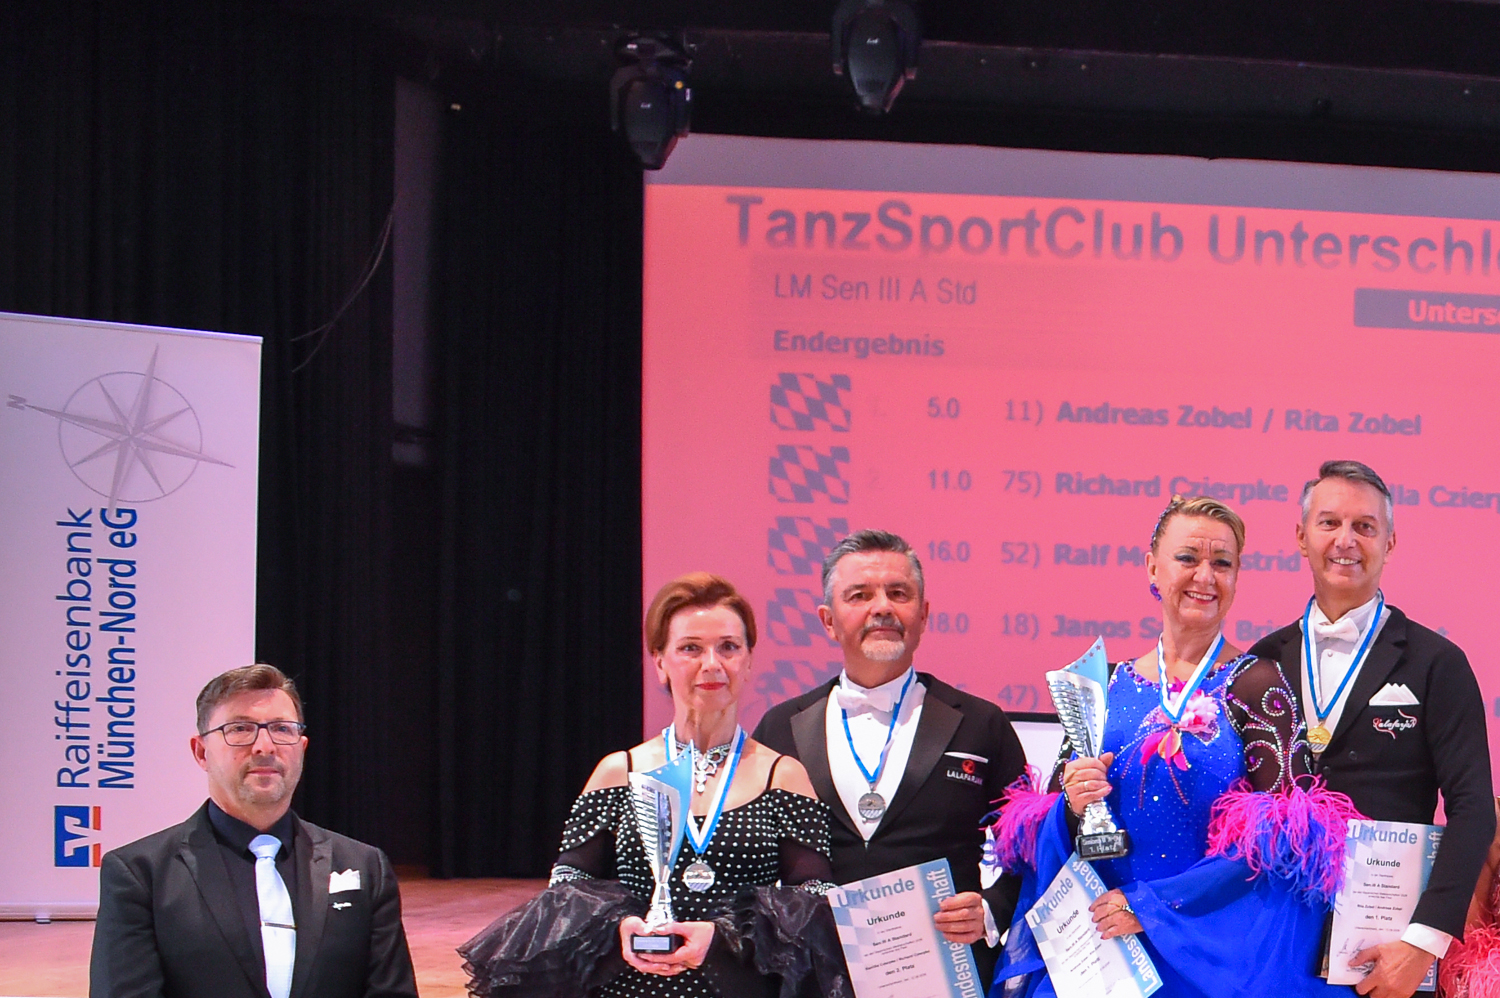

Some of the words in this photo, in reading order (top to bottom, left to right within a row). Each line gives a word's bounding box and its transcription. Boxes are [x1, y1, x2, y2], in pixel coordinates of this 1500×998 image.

[726, 196, 1184, 262] TanzSportClub
[774, 273, 812, 300] LM
[821, 275, 869, 302] Sen
[879, 277, 900, 302] III
[909, 279, 928, 303] A
[936, 280, 977, 305] Std
[773, 329, 945, 359] Endergebnis
[927, 397, 961, 419] 5.0
[1005, 400, 1044, 426] 11)
[1056, 401, 1169, 428] Andreas
[1177, 404, 1253, 431] Zobel
[1263, 408, 1273, 435] /
[1285, 409, 1338, 434] Rita
[1348, 411, 1422, 437] Zobel
[928, 470, 972, 491] 11.0
[1001, 470, 1043, 498] 75)
[1055, 472, 1160, 498] Richard
[1169, 475, 1289, 506] Czierpke
[100, 507, 137, 550] eG
[928, 540, 971, 562] 16.0
[1000, 541, 1041, 569] 52)
[1054, 543, 1111, 567] Ralf
[1241, 550, 1301, 573] strid
[1002, 612, 1041, 640] 18)
[1051, 613, 1132, 640] Janos
[56, 507, 94, 789] Raiffeisenbank
[97, 556, 137, 790] München-Nord
[998, 684, 1038, 711] 47)
[1352, 825, 1418, 845] Urkunde
[1366, 857, 1401, 869] Urkunde
[836, 877, 915, 909] Urkunde
[1030, 876, 1074, 927] Urkunde
[866, 910, 906, 926] Urkunde
[1056, 908, 1080, 935] Urkunde
